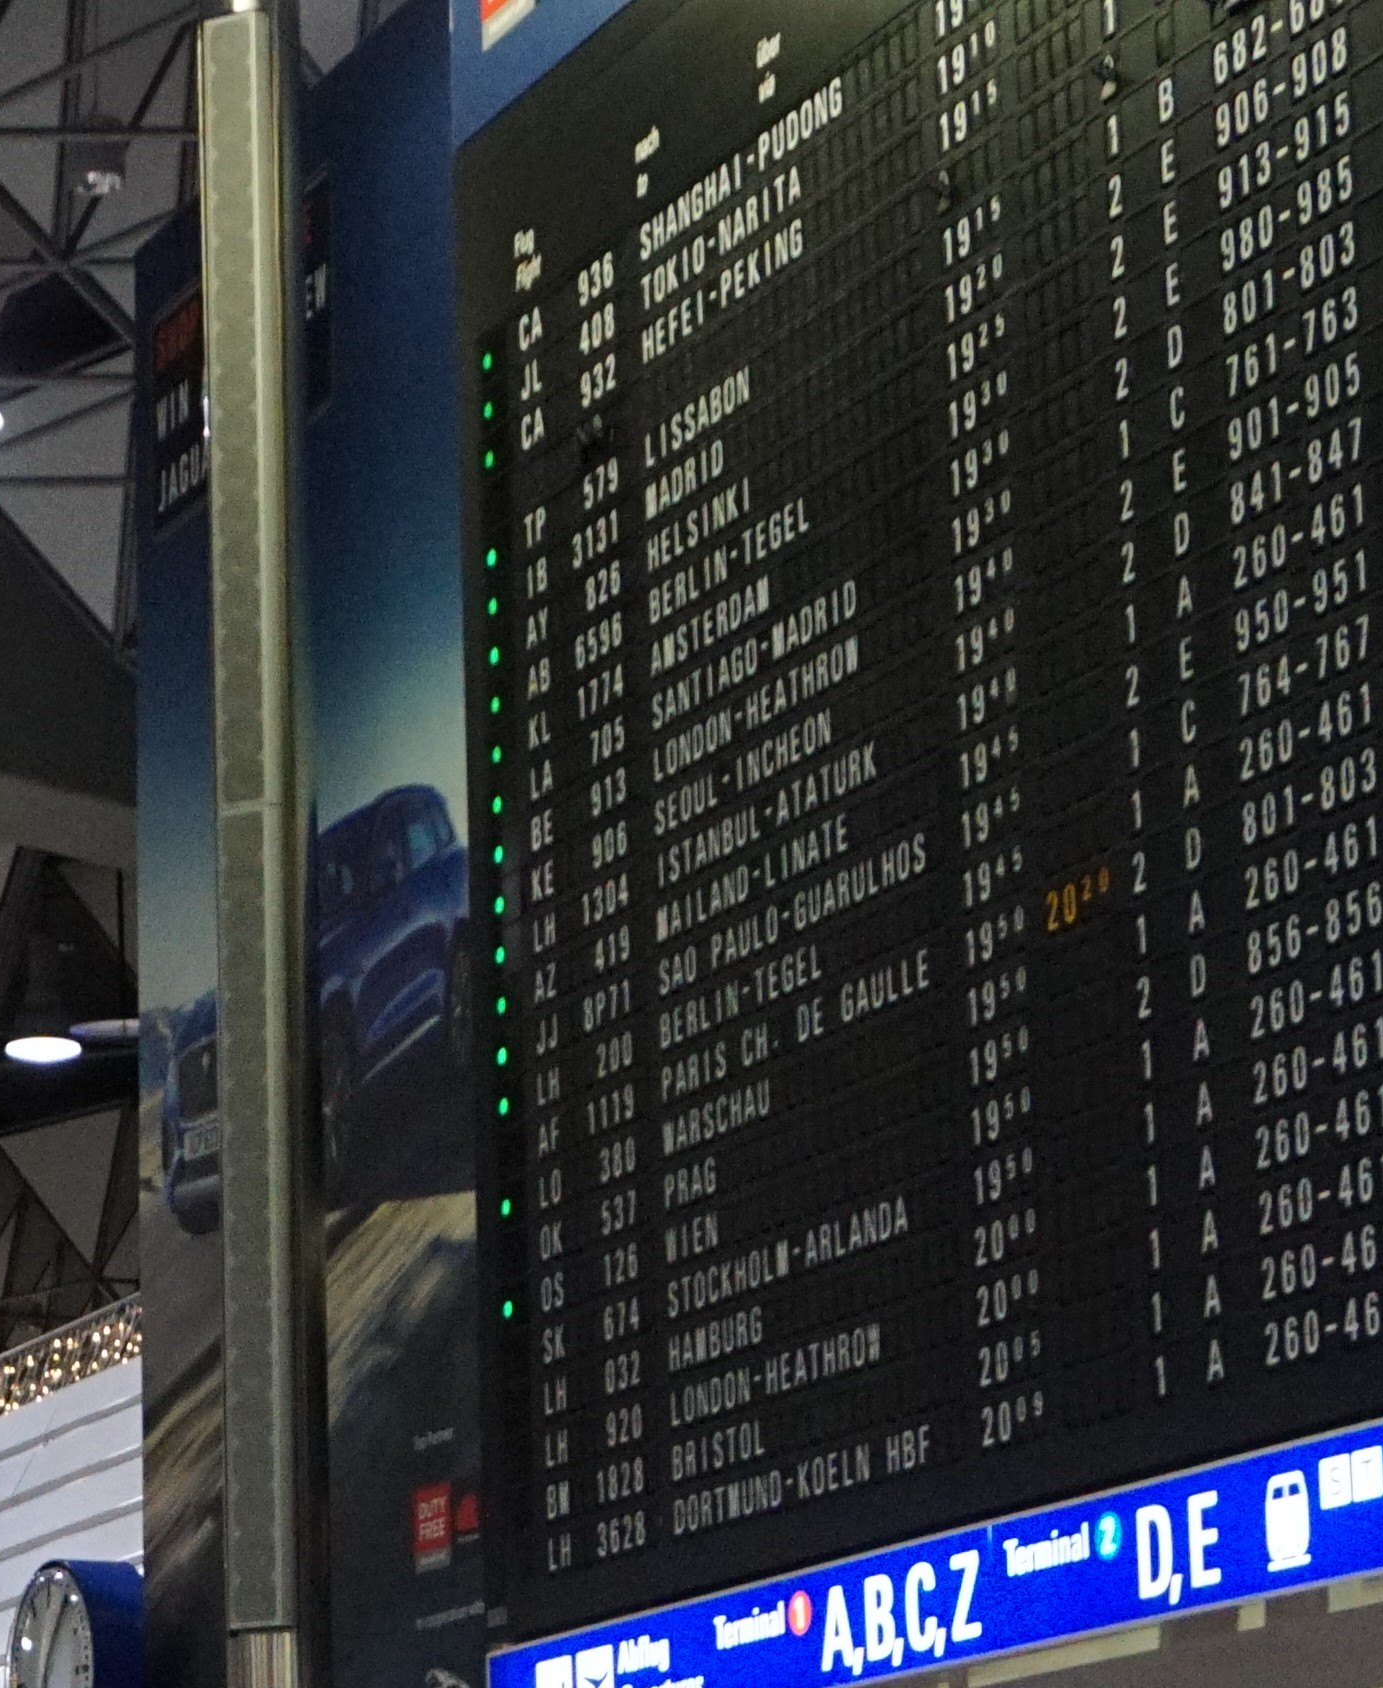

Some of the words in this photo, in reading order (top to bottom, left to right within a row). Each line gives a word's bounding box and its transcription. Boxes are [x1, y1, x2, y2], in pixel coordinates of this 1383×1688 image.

[640, 77, 842, 261] SHANGHAI-PUDONG
[514, 228, 535, 259] Flug
[515, 252, 542, 292] Flight
[641, 166, 801, 310] TOKIO-NARITA
[642, 218, 803, 364] HEFEI-PEKING
[158, 440, 210, 513] JAGU
[645, 365, 749, 468] LISSABON
[529, 711, 551, 750] KL
[578, 663, 623, 720] 1774
[651, 574, 769, 677] AMSTERDAM
[1115, 358, 1129, 401] 2
[1167, 324, 1183, 369] D
[1223, 221, 1355, 334] 801-803
[645, 439, 723, 520] MADRID
[647, 476, 749, 572] HELSINKI
[649, 497, 809, 624] BERLIN-TEGEL
[652, 580, 856, 730] SANTIAGO-MADRID
[653, 635, 858, 782] LONDON-HEATHROW
[654, 708, 831, 836] SEOUL-INCHEON
[658, 741, 876, 886] ISTANBUL-ATATURK
[656, 813, 848, 942] MAILAND-LINATE
[659, 946, 696, 995] SAO
[712, 832, 926, 968] PAULO-GUARULHOS
[660, 945, 821, 1049] BERLIN-TEGEL
[662, 1041, 726, 1101] PARIS
[797, 997, 824, 1042] DE
[841, 949, 929, 1022] GAULLE
[663, 1079, 769, 1155] WARSCHAU
[664, 1157, 715, 1208] PRAG
[665, 1214, 717, 1262] WIEN
[668, 1195, 908, 1318] STOCKHOLM-ARLANDA
[669, 1306, 762, 1370] HAMBURG
[671, 1324, 880, 1426] LONDON-HEATHROW
[548, 1534, 570, 1571] LH
[597, 1511, 645, 1557] 3628
[674, 1444, 869, 1535] DORTMUND-KOELN
[887, 1424, 929, 1473] HBF
[1155, 1356, 1166, 1396] 1
[1207, 1339, 1224, 1382] A
[672, 1421, 765, 1481] BRISTOL
[419, 1518, 446, 1541] FREE
[617, 1635, 670, 1674] Abflug
[713, 1600, 786, 1650] Terminal
[819, 1549, 984, 1677] A,B,C,Z
[1002, 1521, 1091, 1578] Terminal
[1135, 1489, 1223, 1602] D,E
